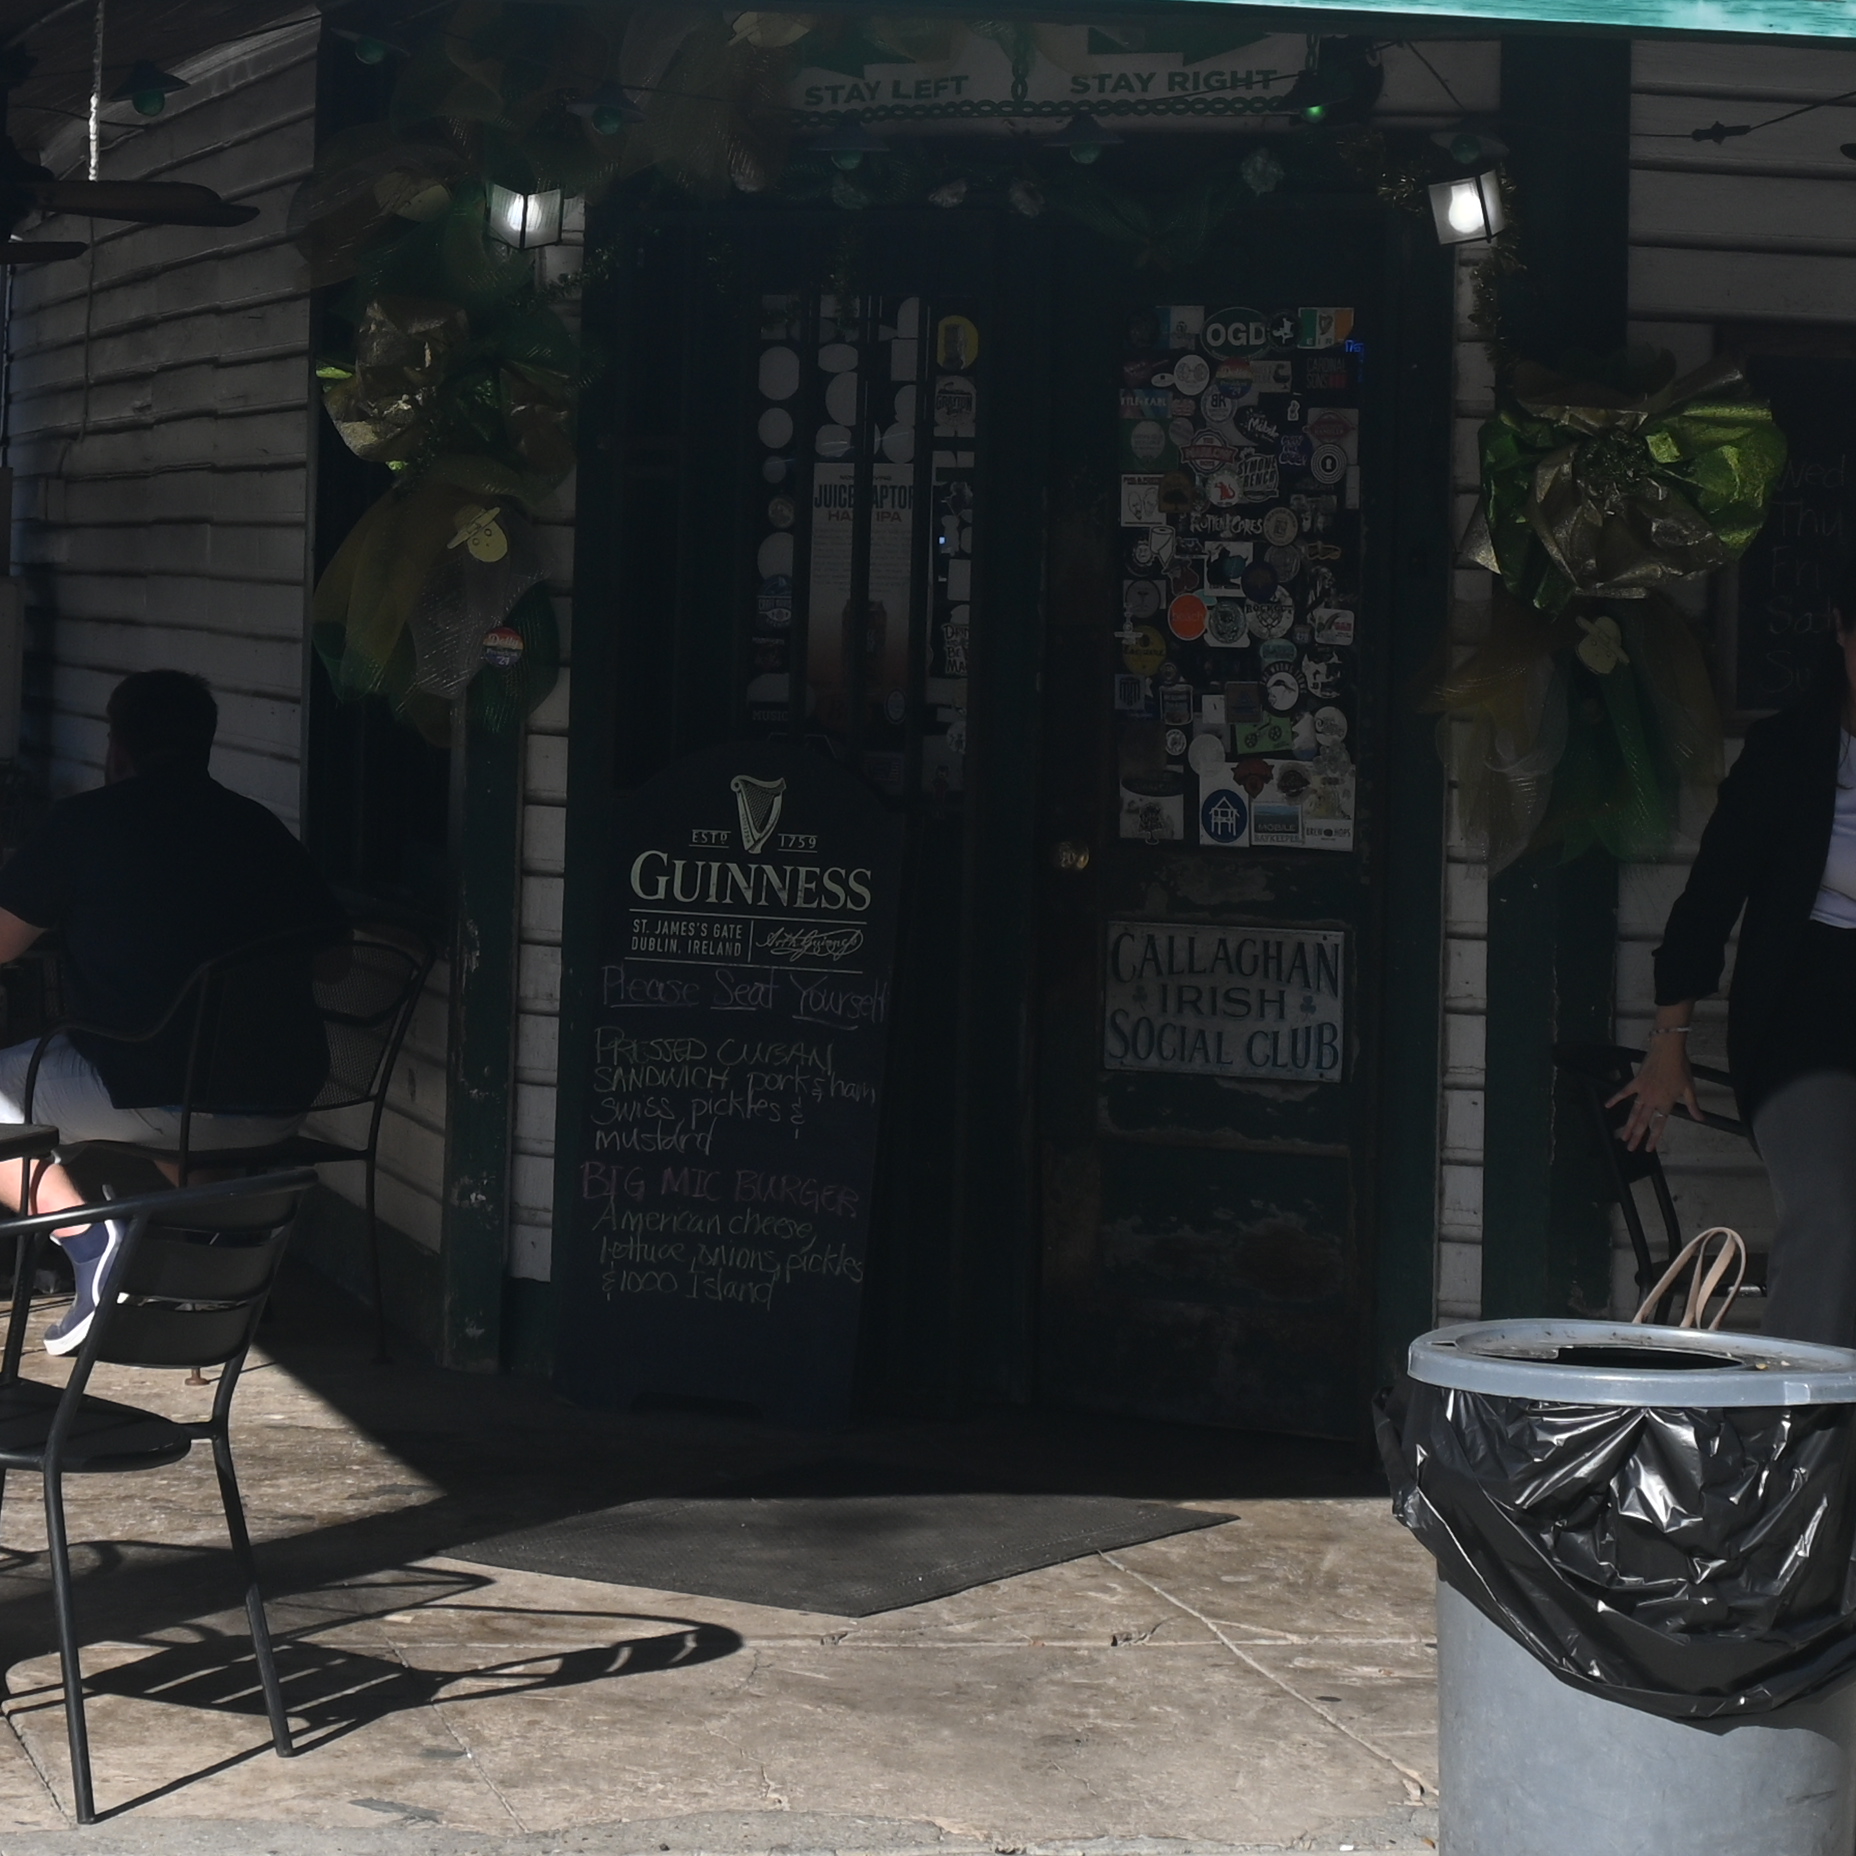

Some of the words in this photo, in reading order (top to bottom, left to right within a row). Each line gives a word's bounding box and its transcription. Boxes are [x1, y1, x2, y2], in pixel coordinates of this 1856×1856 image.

[804, 78, 882, 107] STAY
[891, 75, 969, 101] LEFT
[1069, 71, 1157, 95] STAY
[1167, 68, 1278, 92] RIGHT
[1206, 322, 1267, 347] OGD
[876, 510, 903, 523] IPA
[1770, 499, 1844, 537] Thu
[1771, 545, 1820, 589] Fri
[752, 710, 789, 722] MUSIC
[778, 835, 818, 849] 1759
[1258, 823, 1296, 832] MOBILE
[629, 849, 872, 912] GUINNESS
[632, 919, 649, 934] ST.
[655, 921, 709, 937] JAMES'S
[713, 924, 743, 939] GATE
[687, 940, 742, 957] IRELAND
[1111, 931, 1340, 999] CALLAGHAN
[601, 964, 700, 1006] Please
[713, 967, 780, 1009] Seat
[789, 972, 889, 1024] Yourself
[1160, 984, 1287, 1020] IRISH
[717, 1037, 834, 1076] CUBAN
[1108, 1008, 1233, 1066] SOCIAL
[1246, 1021, 1340, 1072] CLUB
[594, 1064, 729, 1093] SANDWICH
[595, 1117, 718, 1156] mustard
[581, 1161, 645, 1202] BIG
[661, 1166, 721, 1202] MIC
[734, 1169, 860, 1218] BURGER
[592, 1198, 721, 1232] American
[620, 1270, 678, 1293] 1000
[685, 1269, 777, 1312] Island
